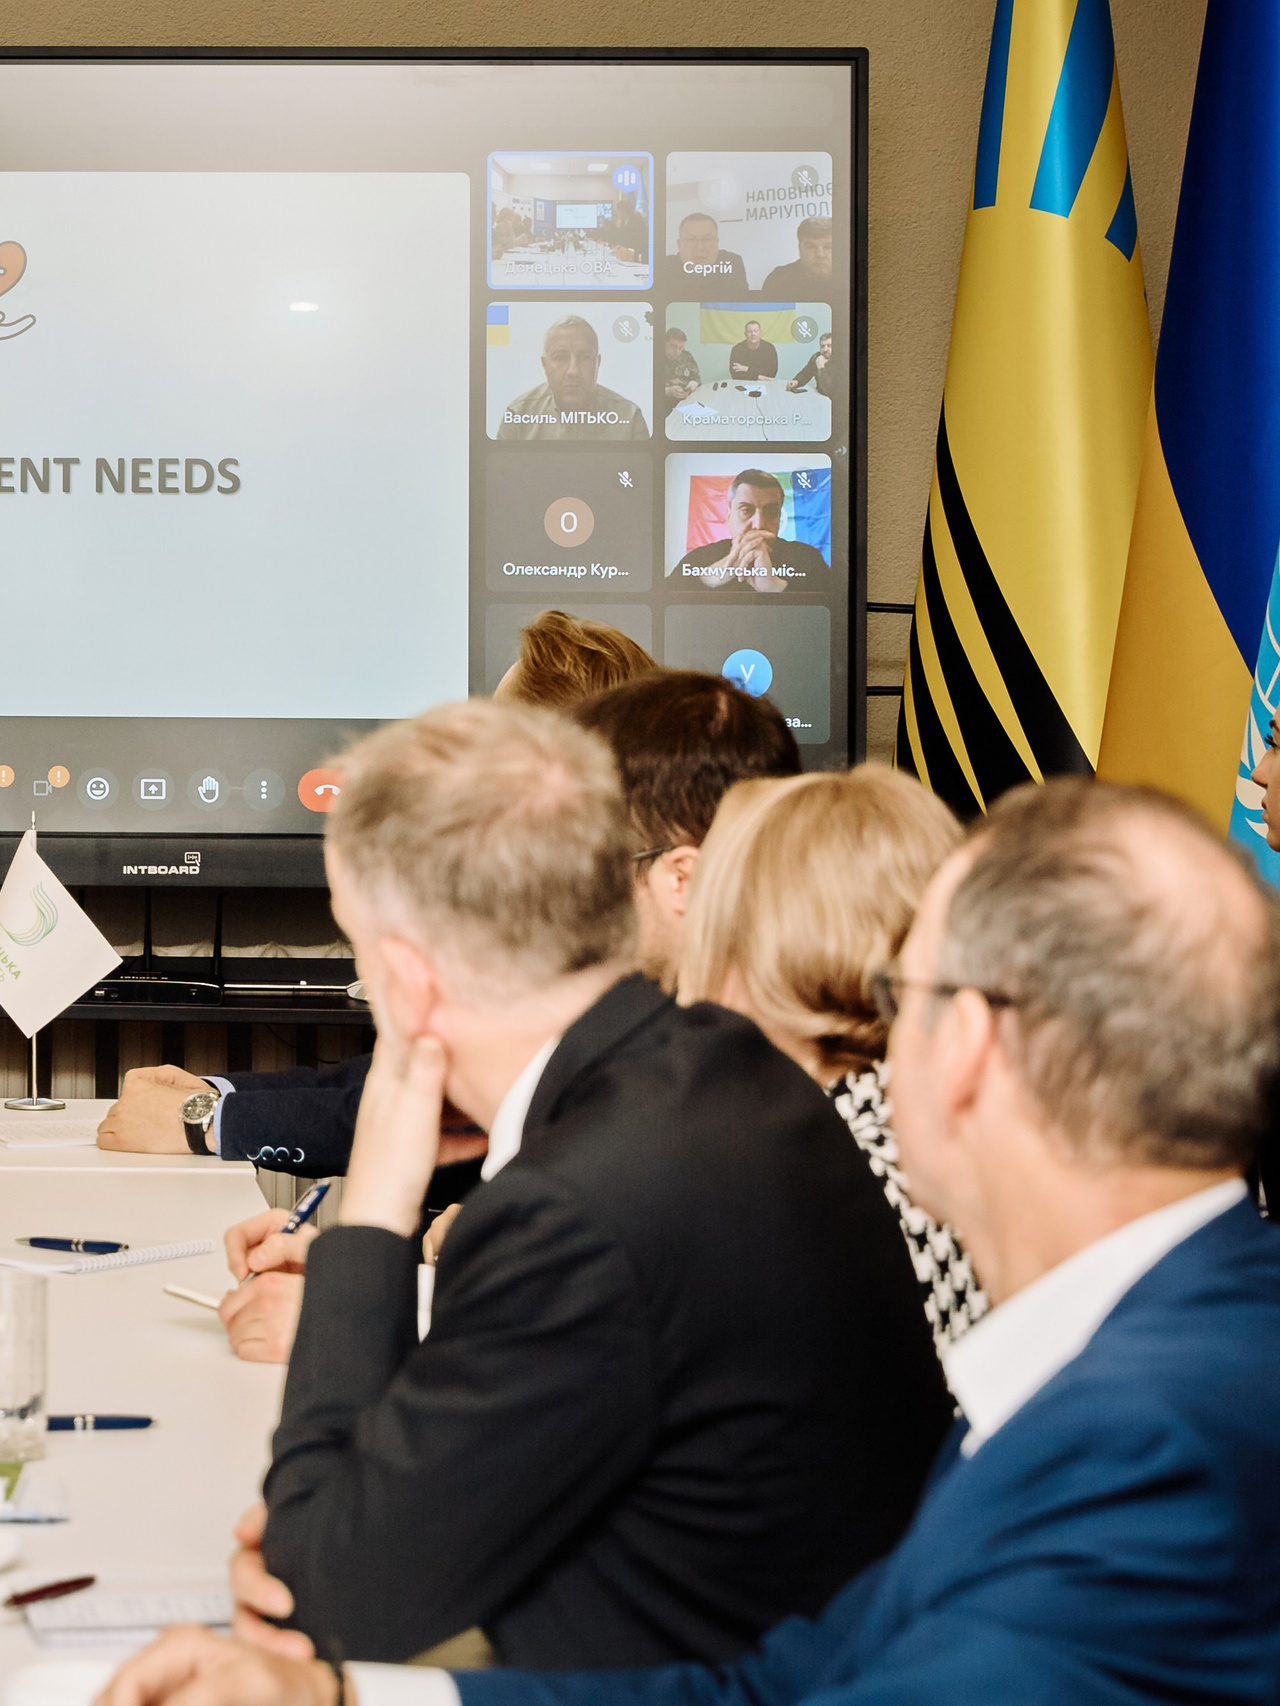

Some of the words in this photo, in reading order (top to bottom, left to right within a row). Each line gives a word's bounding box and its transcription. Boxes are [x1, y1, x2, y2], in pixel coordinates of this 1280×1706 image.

[504, 261, 576, 276] Донецька
[580, 261, 613, 274] ОВА
[683, 260, 733, 275] Сергій
[503, 411, 557, 425] Василь
[560, 411, 630, 424] МІТЬКО...
[682, 413, 789, 427] Краматорська
[95, 457, 241, 494] NEEDS
[502, 562, 587, 578] Олександр
[590, 563, 629, 578] Кур...
[682, 563, 768, 578] Бахмутська
[123, 865, 200, 875] INTBOARD
